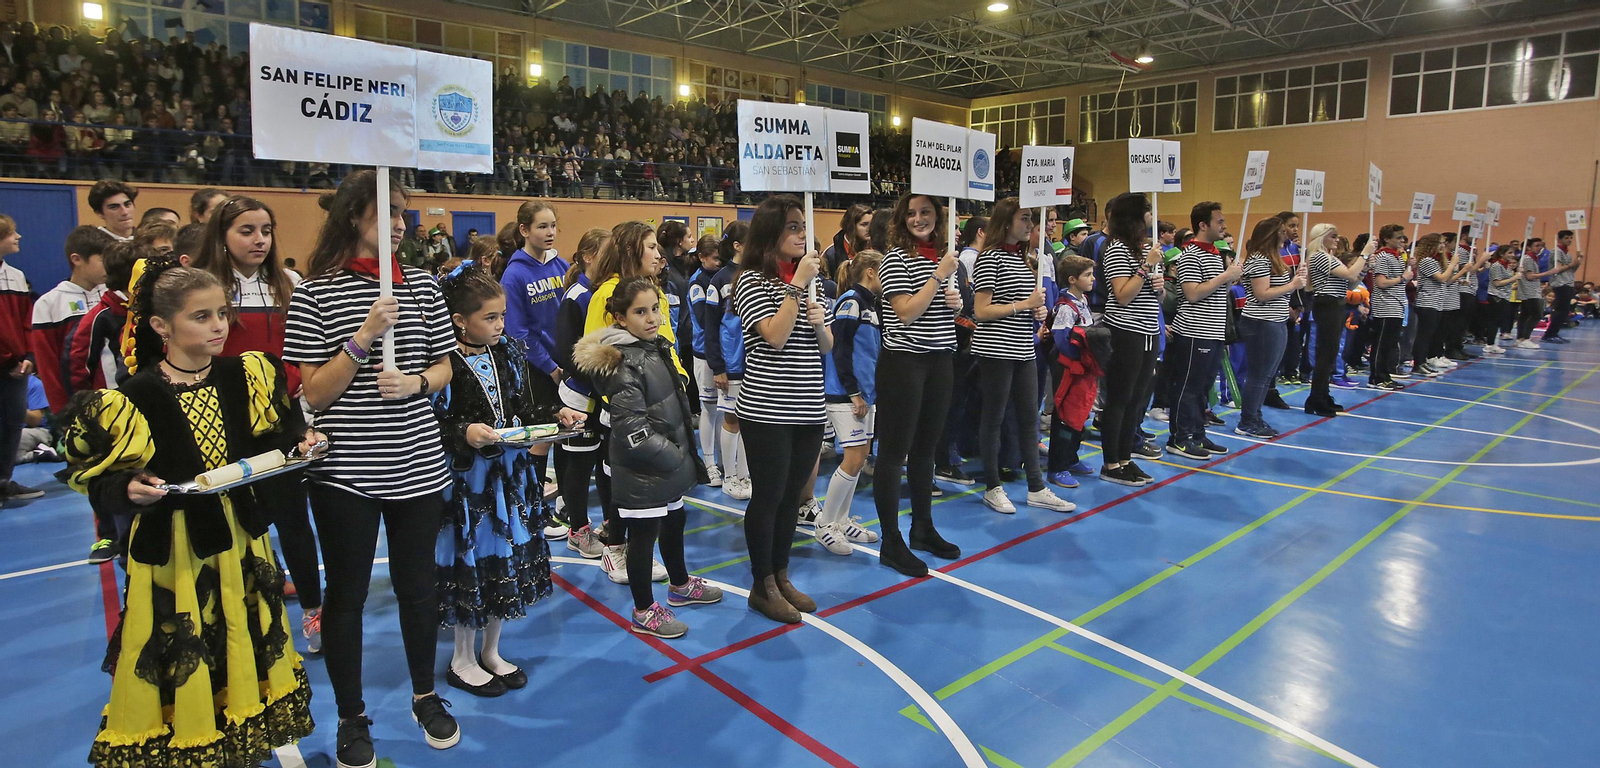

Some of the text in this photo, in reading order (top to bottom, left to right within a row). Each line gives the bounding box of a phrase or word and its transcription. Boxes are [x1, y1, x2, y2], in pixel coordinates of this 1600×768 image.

[260, 66, 405, 97] SAN FELIPE NERI
[301, 93, 372, 123] CÁDIZ
[754, 117, 811, 135] SUMMA
[743, 143, 823, 160] ALDAPETA
[837, 145, 859, 154] SUMMA
[916, 139, 926, 148] STA
[936, 143, 946, 151] DEL
[947, 145, 962, 153] PILAR
[915, 154, 962, 172] ZARAGOZA
[1130, 154, 1161, 163] ORCASITAS
[753, 165, 769, 175] SAN
[1027, 175, 1053, 184] DEL PILAR
[526, 275, 565, 297] SUMM
